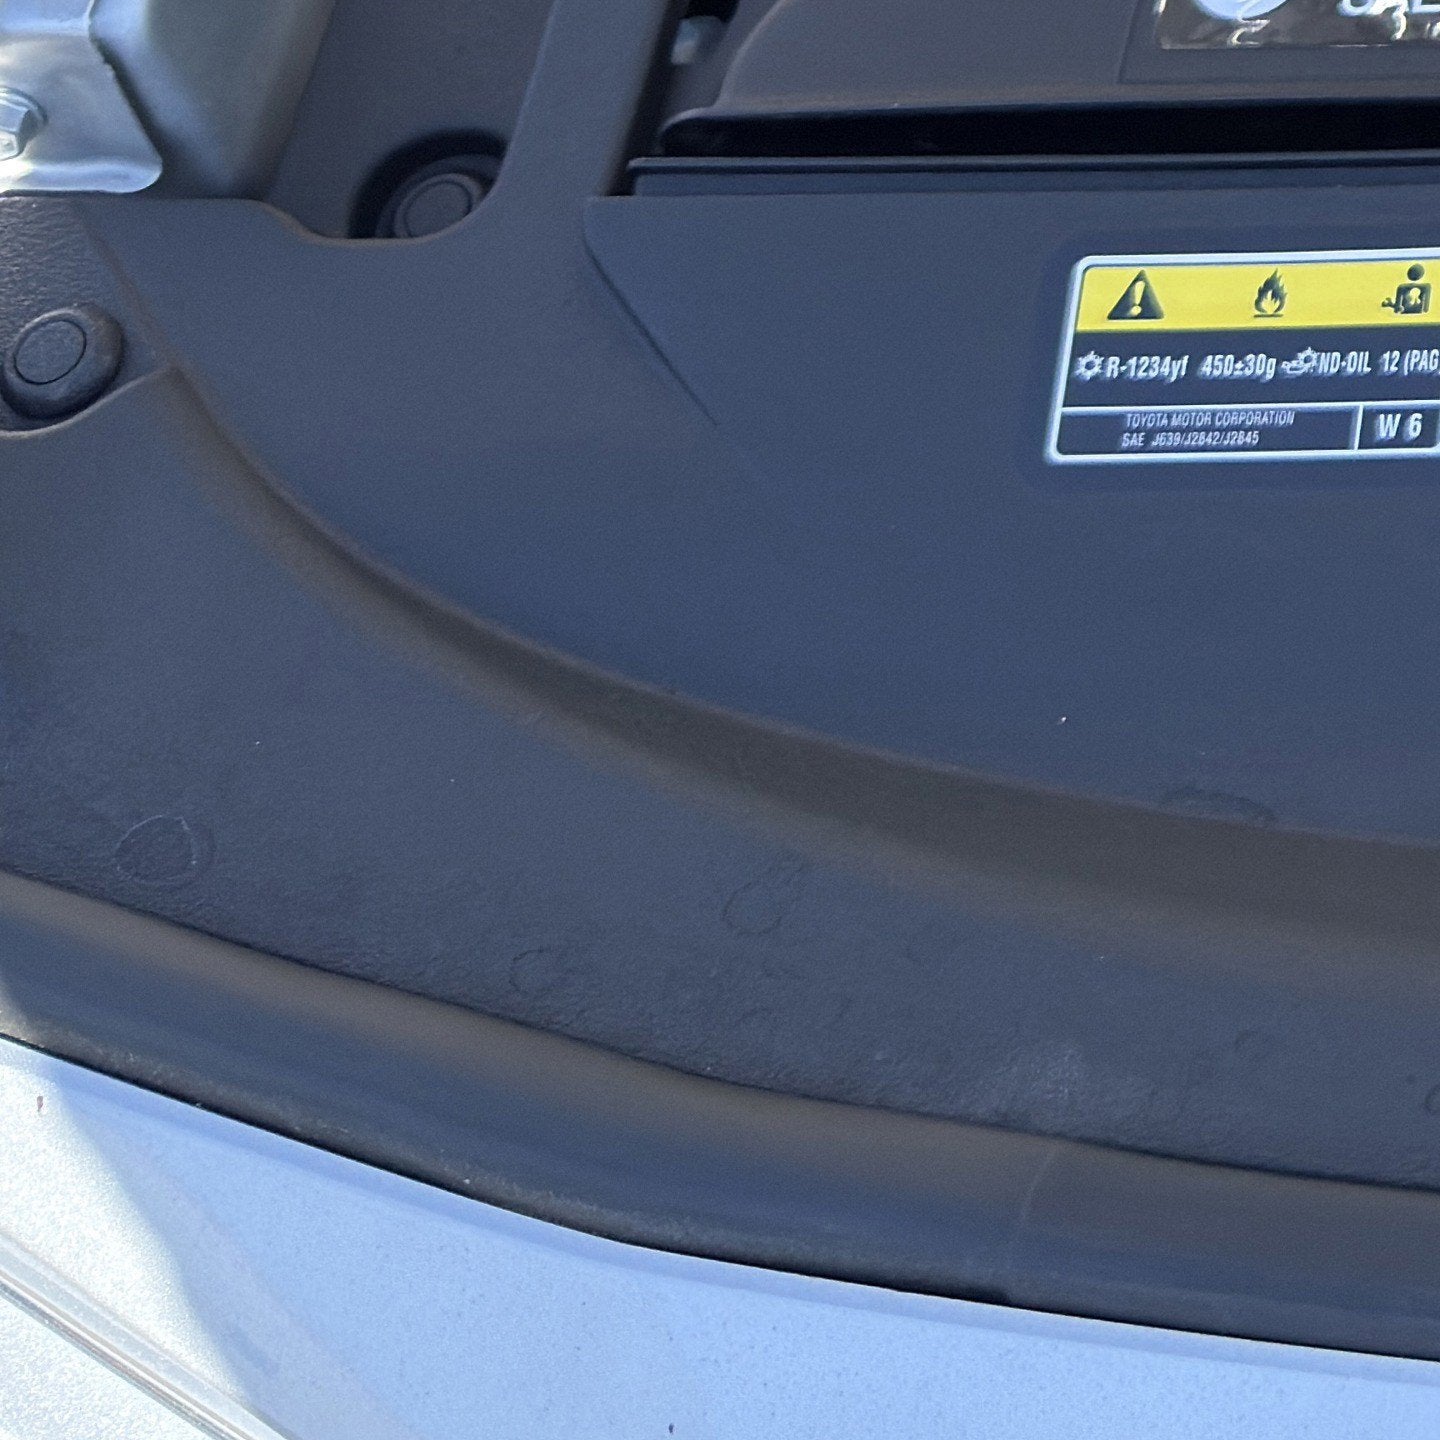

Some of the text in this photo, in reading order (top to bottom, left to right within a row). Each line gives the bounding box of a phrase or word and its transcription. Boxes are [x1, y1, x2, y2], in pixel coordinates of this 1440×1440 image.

[1106, 354, 1189, 382] R-1234yf
[1200, 353, 1277, 381] 450±30g
[1318, 350, 1373, 375] ND-OIL
[1381, 350, 1400, 373] 12
[1125, 410, 1295, 428] TOYOTA MOTOR CORPORATION
[1376, 412, 1424, 439] W 6
[1121, 432, 1145, 448] SAE
